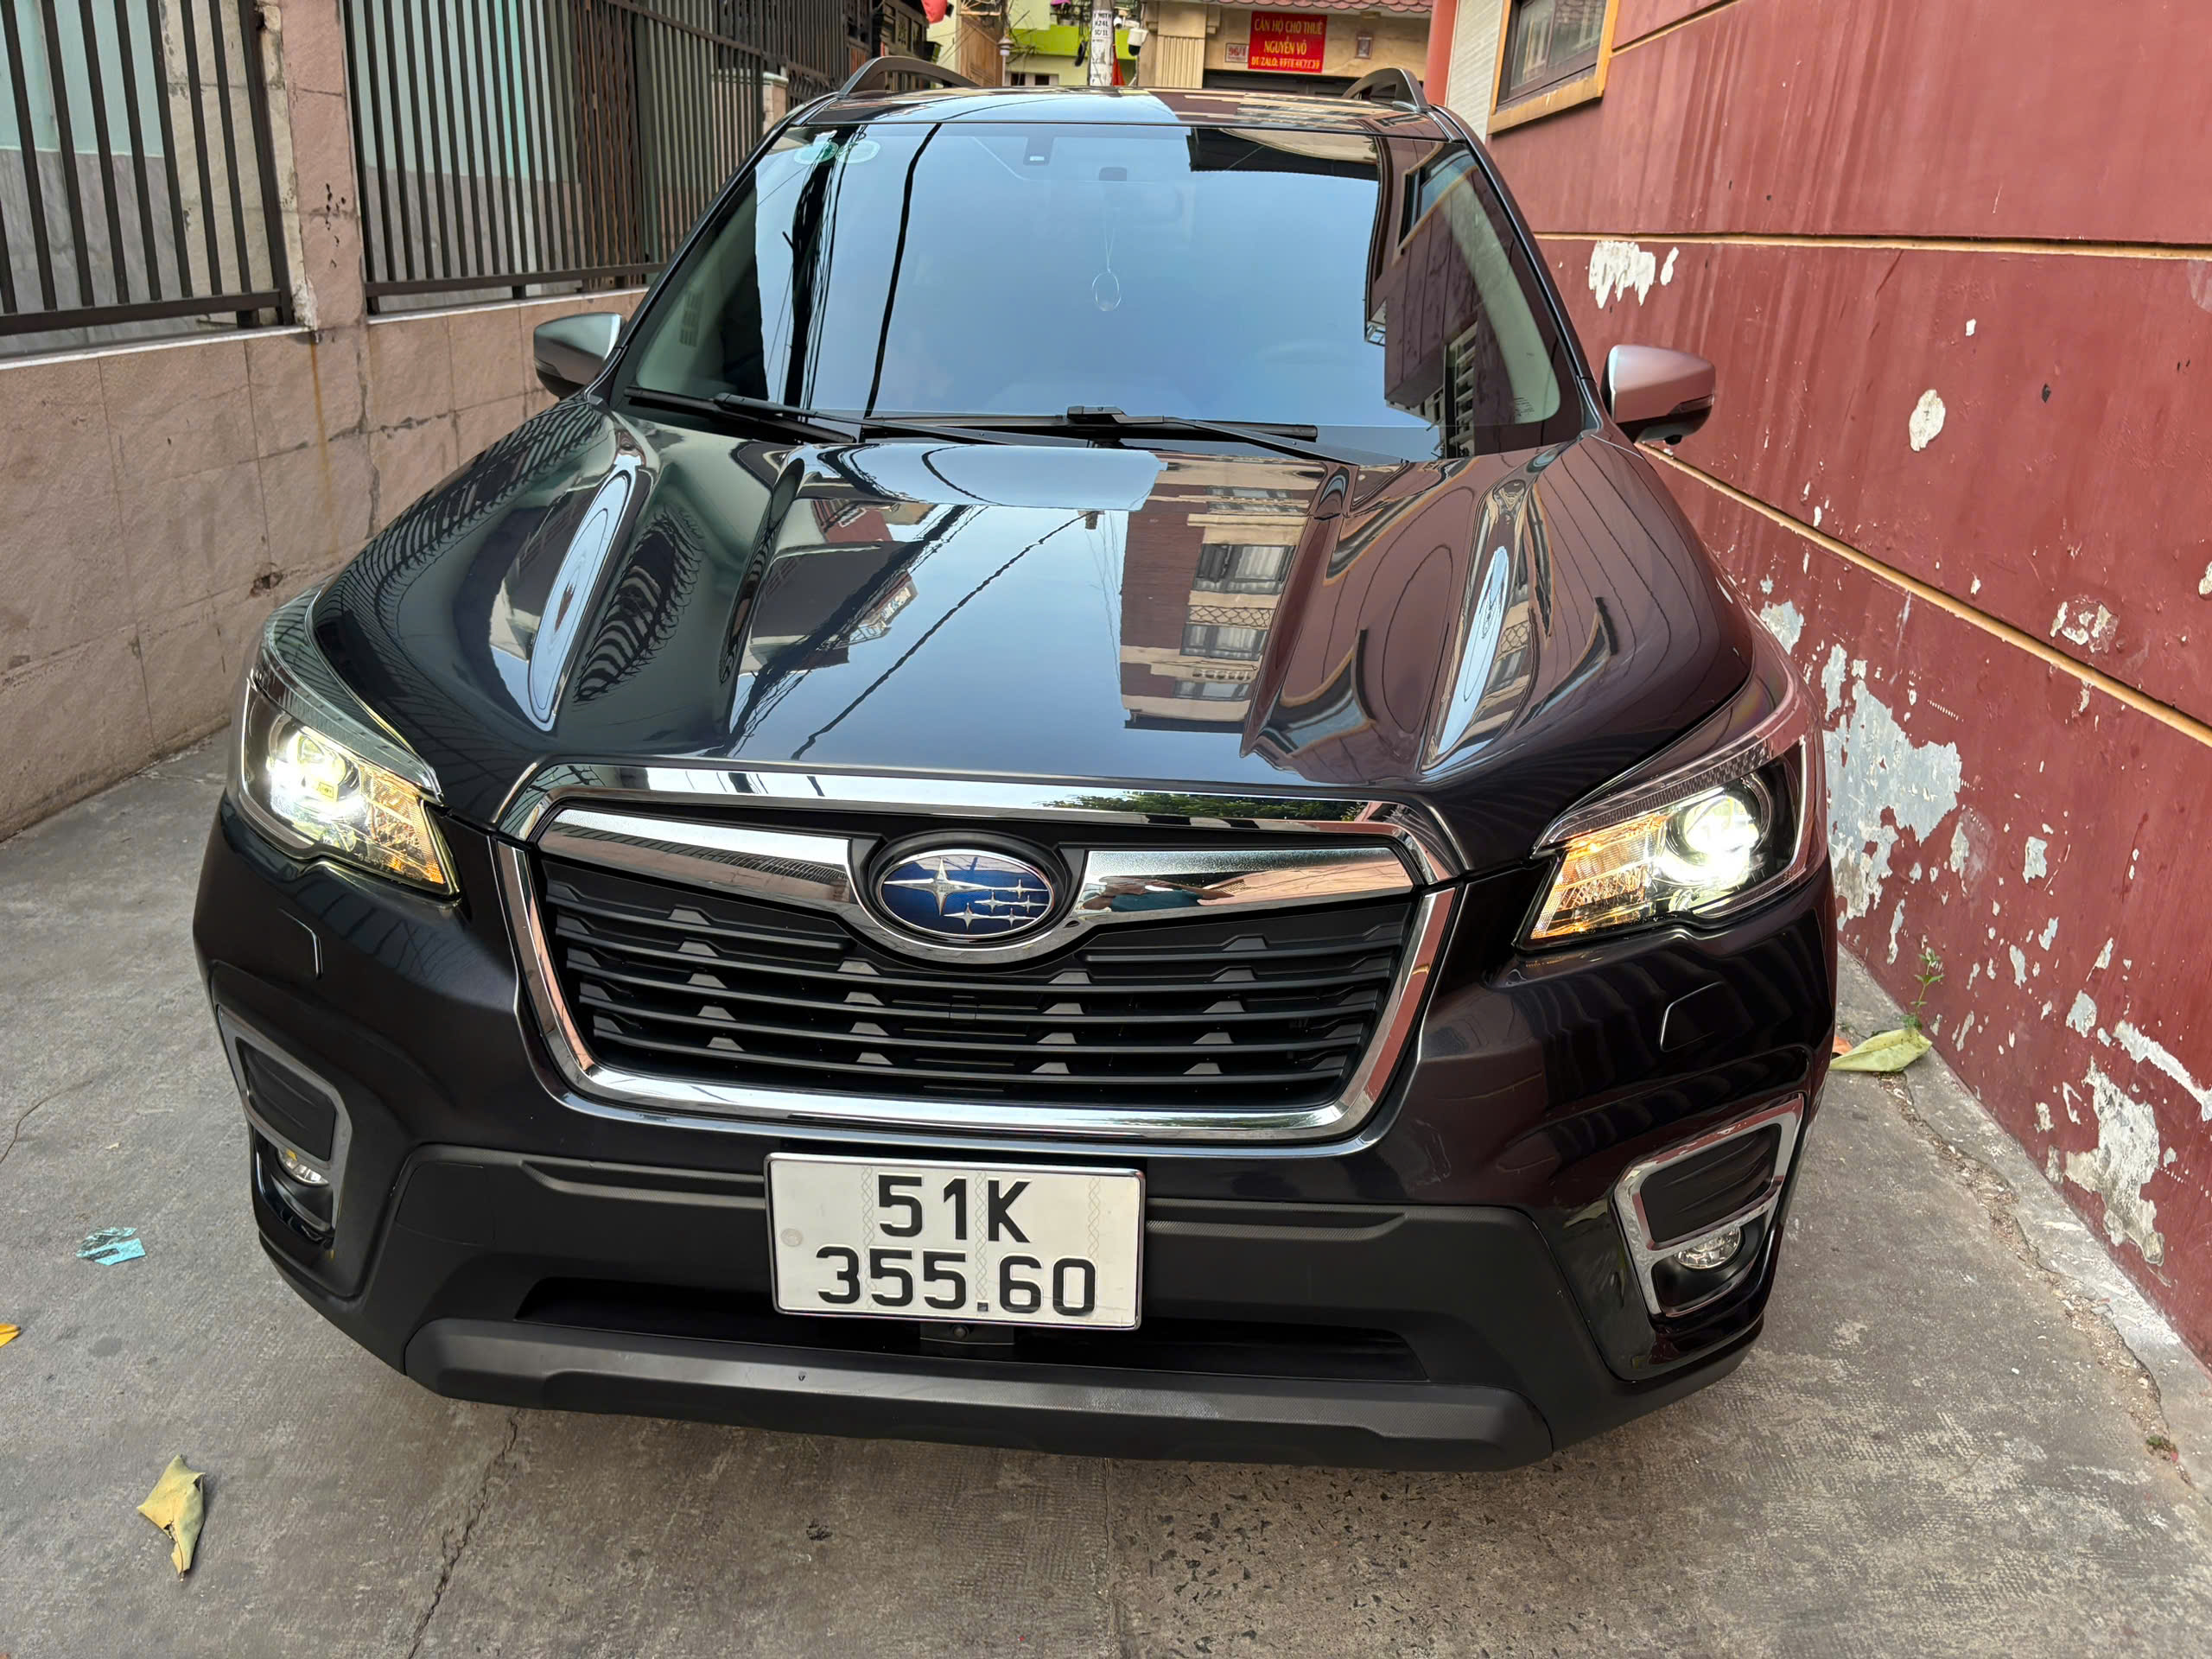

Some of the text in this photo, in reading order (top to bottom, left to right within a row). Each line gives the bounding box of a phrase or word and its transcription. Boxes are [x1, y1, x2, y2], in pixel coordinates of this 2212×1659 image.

[1285, 20, 1302, 34] CHO
[878, 1173, 1032, 1243] 51K
[816, 1244, 1096, 1316] 355.60
